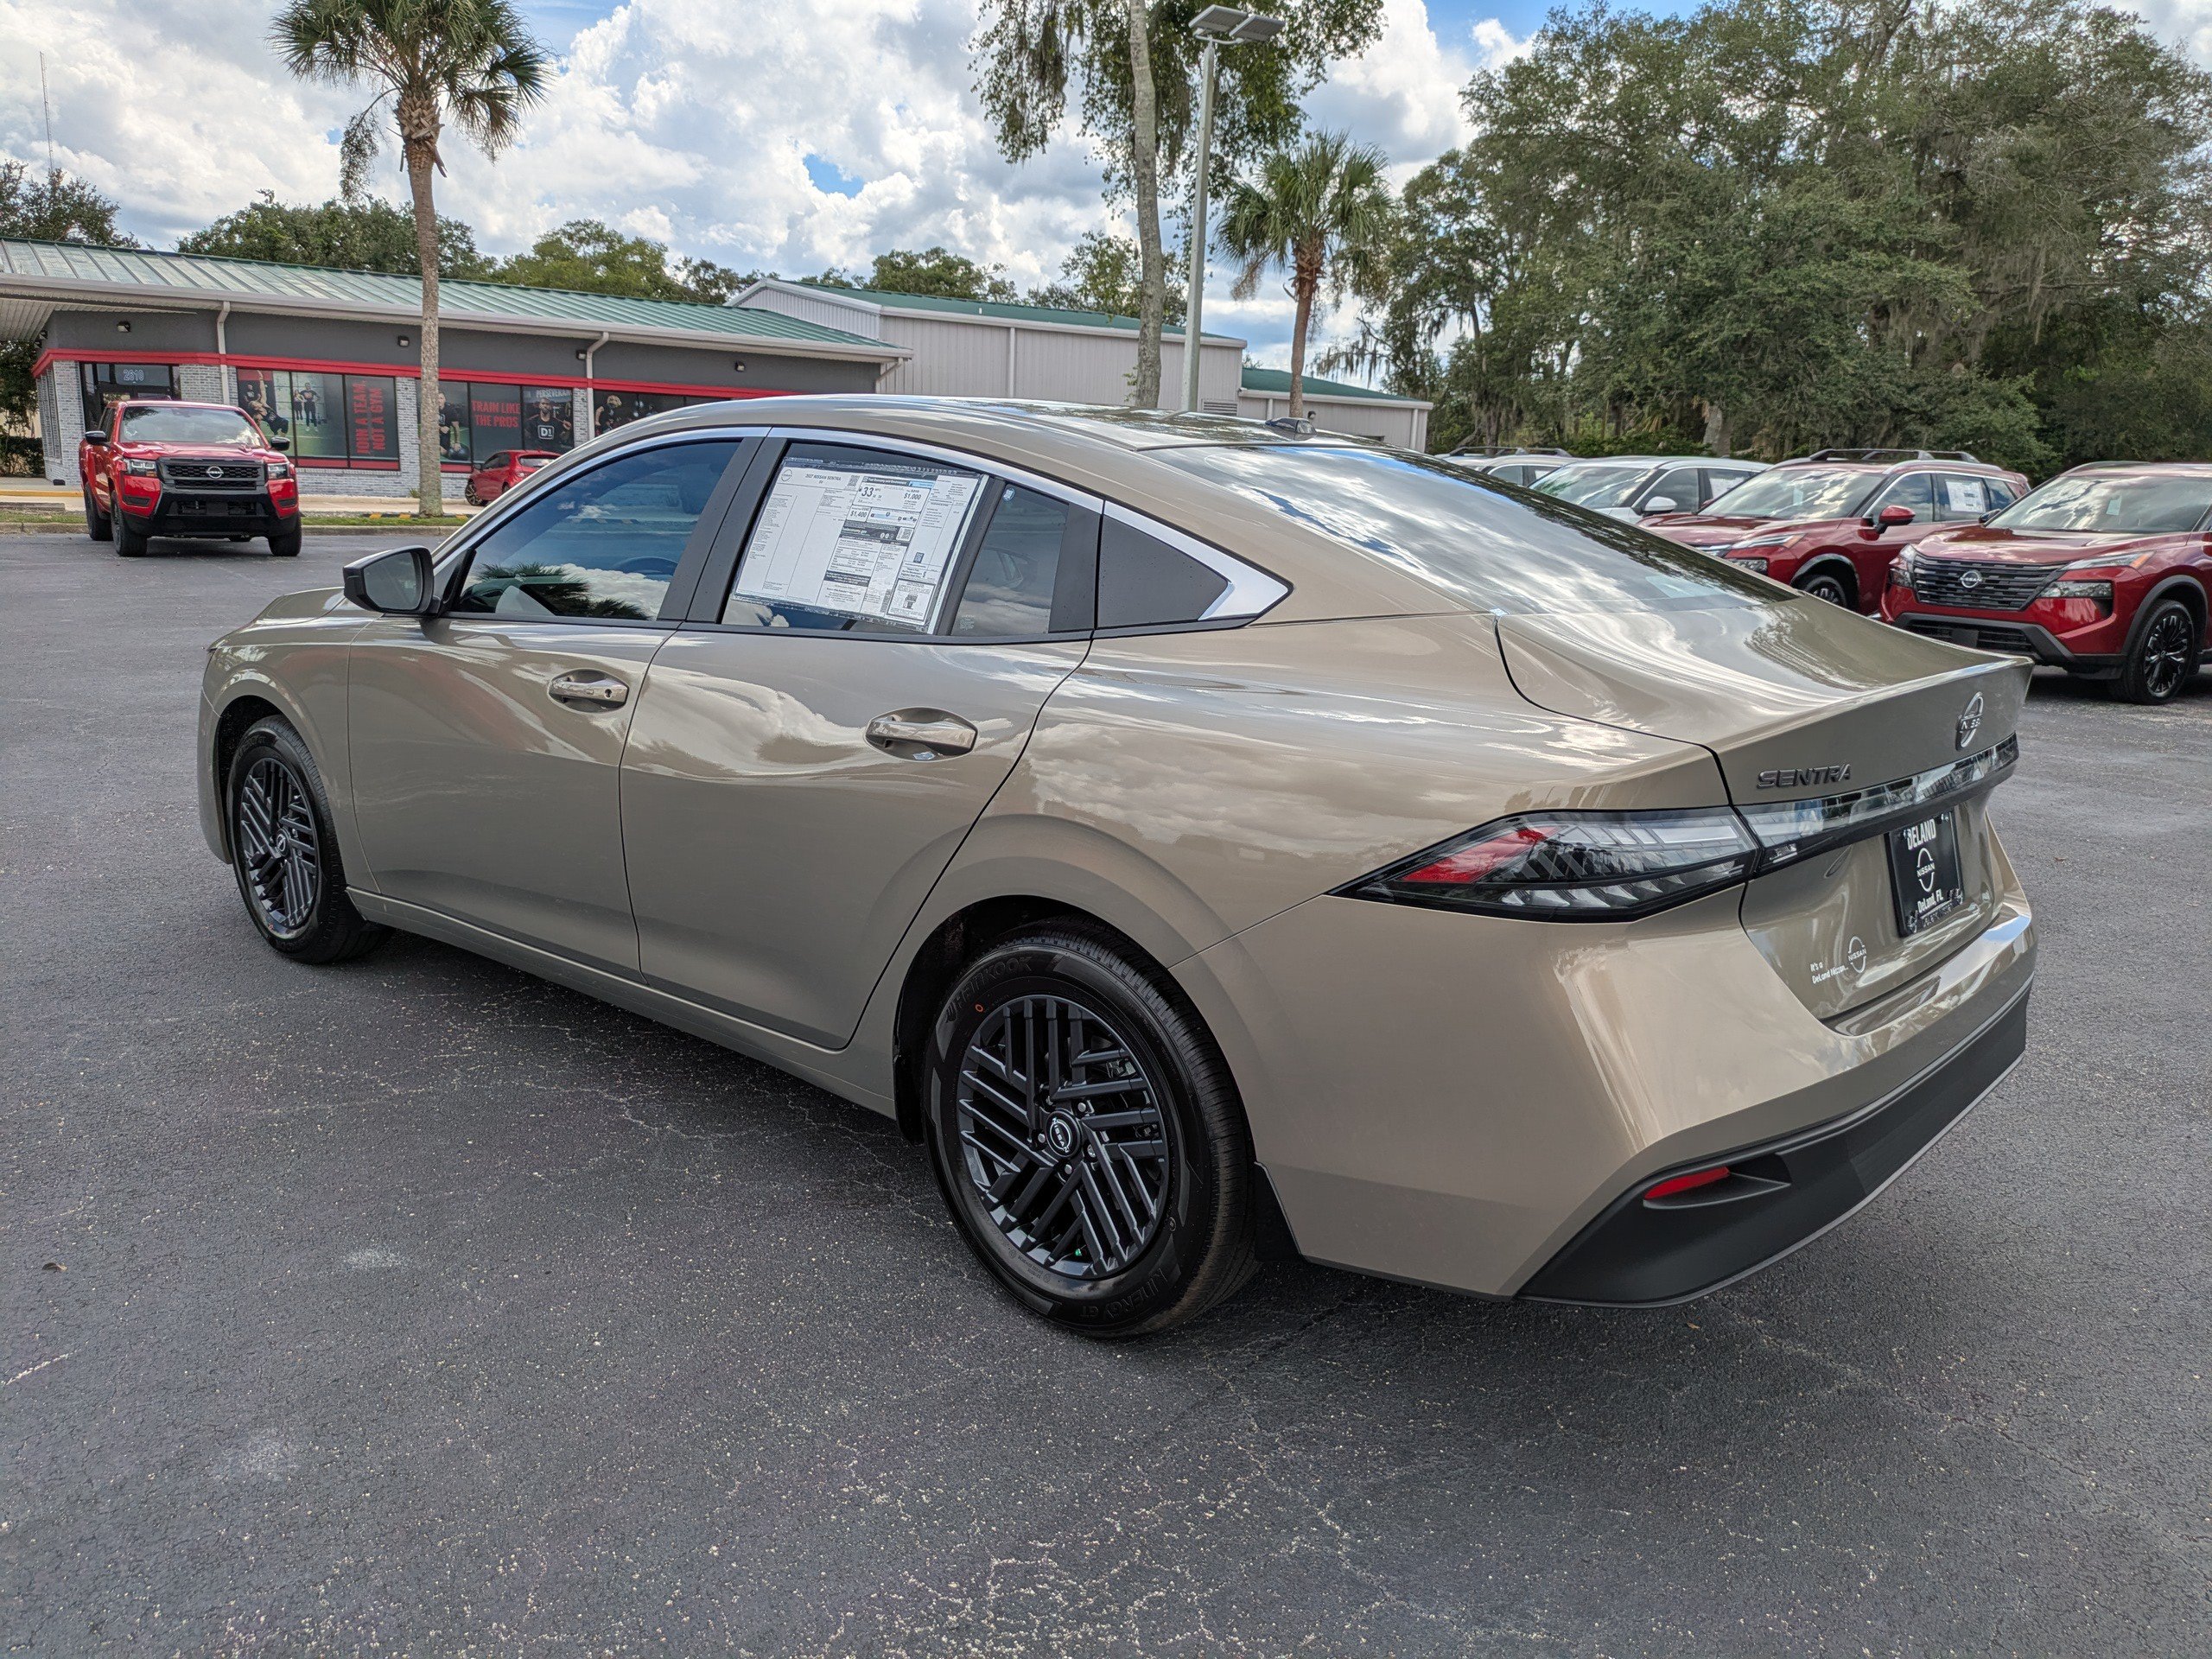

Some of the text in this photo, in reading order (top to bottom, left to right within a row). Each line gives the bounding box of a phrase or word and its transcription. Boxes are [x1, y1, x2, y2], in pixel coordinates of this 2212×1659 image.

[472, 400, 521, 414] TRAIN LIKE
[369, 388, 386, 450] NOT A GYM
[475, 415, 518, 428] THE PROS
[540, 428, 553, 437] D1
[356, 428, 369, 454] JOIN
[861, 486, 874, 497] 33
[1757, 763, 1851, 789] SENTRA
[1906, 818, 1936, 850] DELAND
[1916, 862, 1936, 878] NISSAN
[1848, 948, 1866, 962] NISSAN
[1810, 962, 1819, 971] It's
[1052, 1116, 1070, 1154] NISSAN
